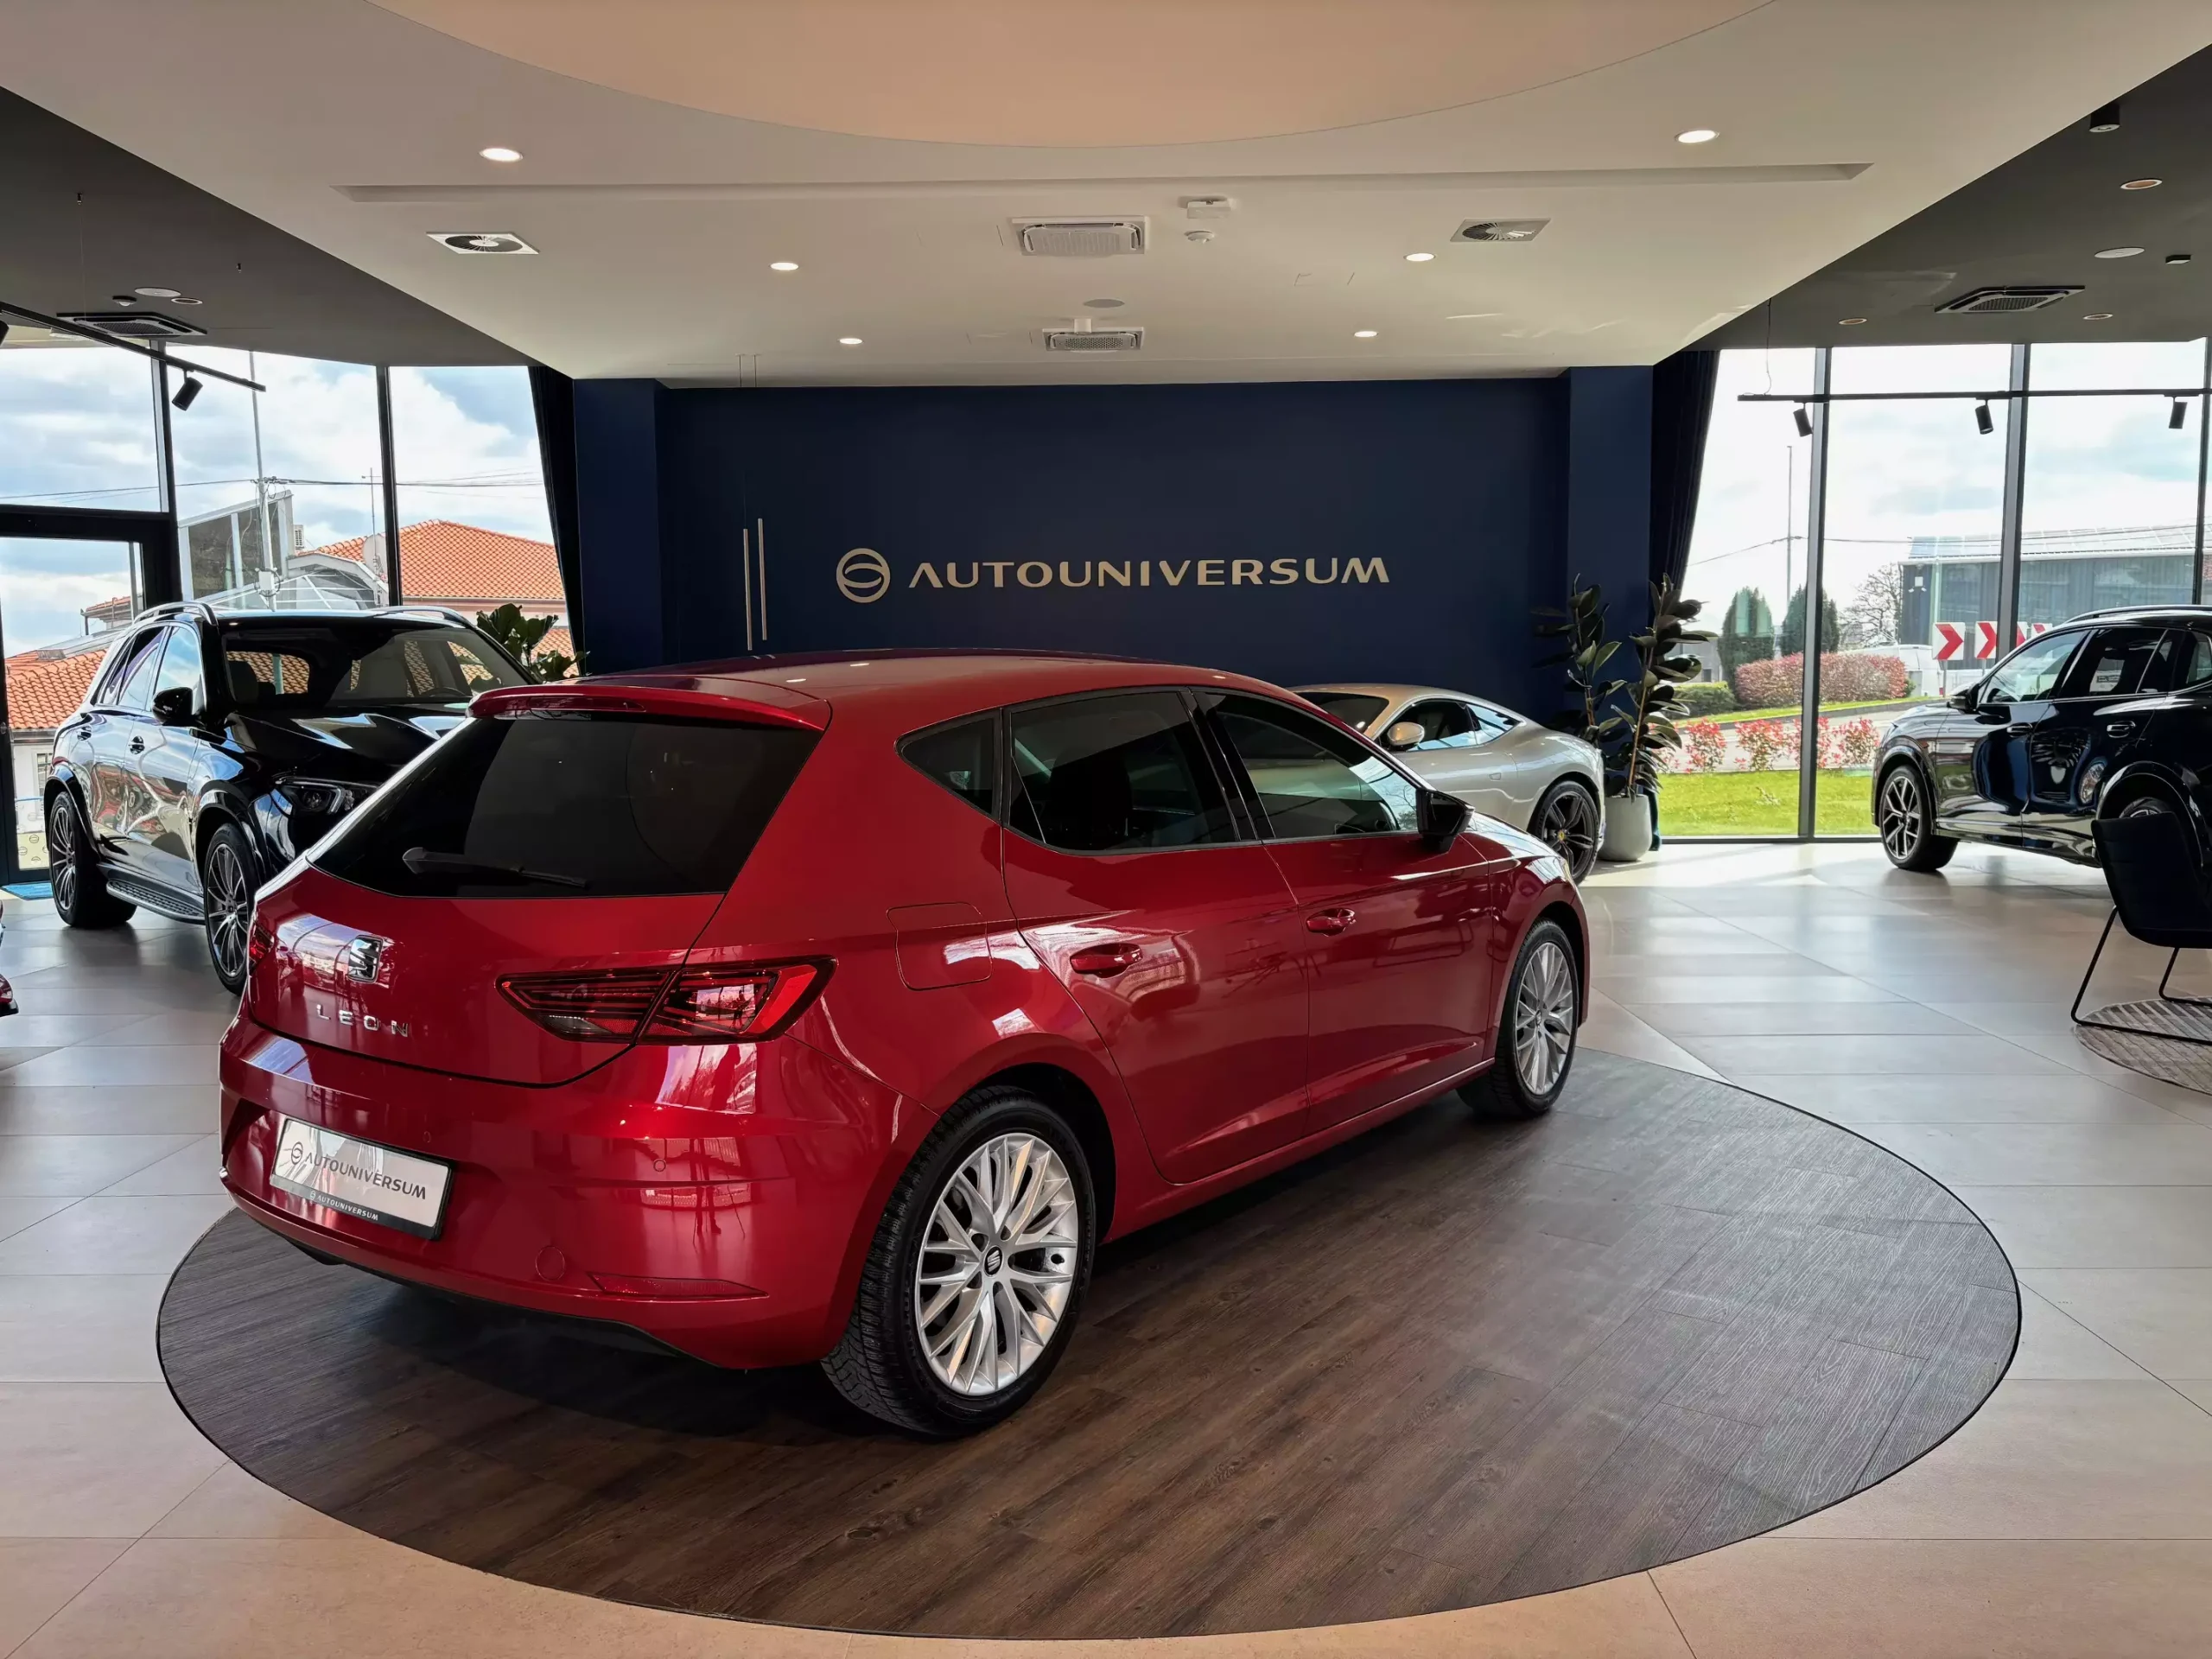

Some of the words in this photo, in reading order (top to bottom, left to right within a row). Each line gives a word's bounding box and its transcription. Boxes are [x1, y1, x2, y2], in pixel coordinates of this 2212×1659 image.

[909, 556, 1390, 588] AUTOUNIVERSUM
[316, 1004, 409, 1038] LEON
[304, 1152, 427, 1200] AUTOUNIVERSUM
[317, 1194, 379, 1221] AUTOUNIVERSUM
